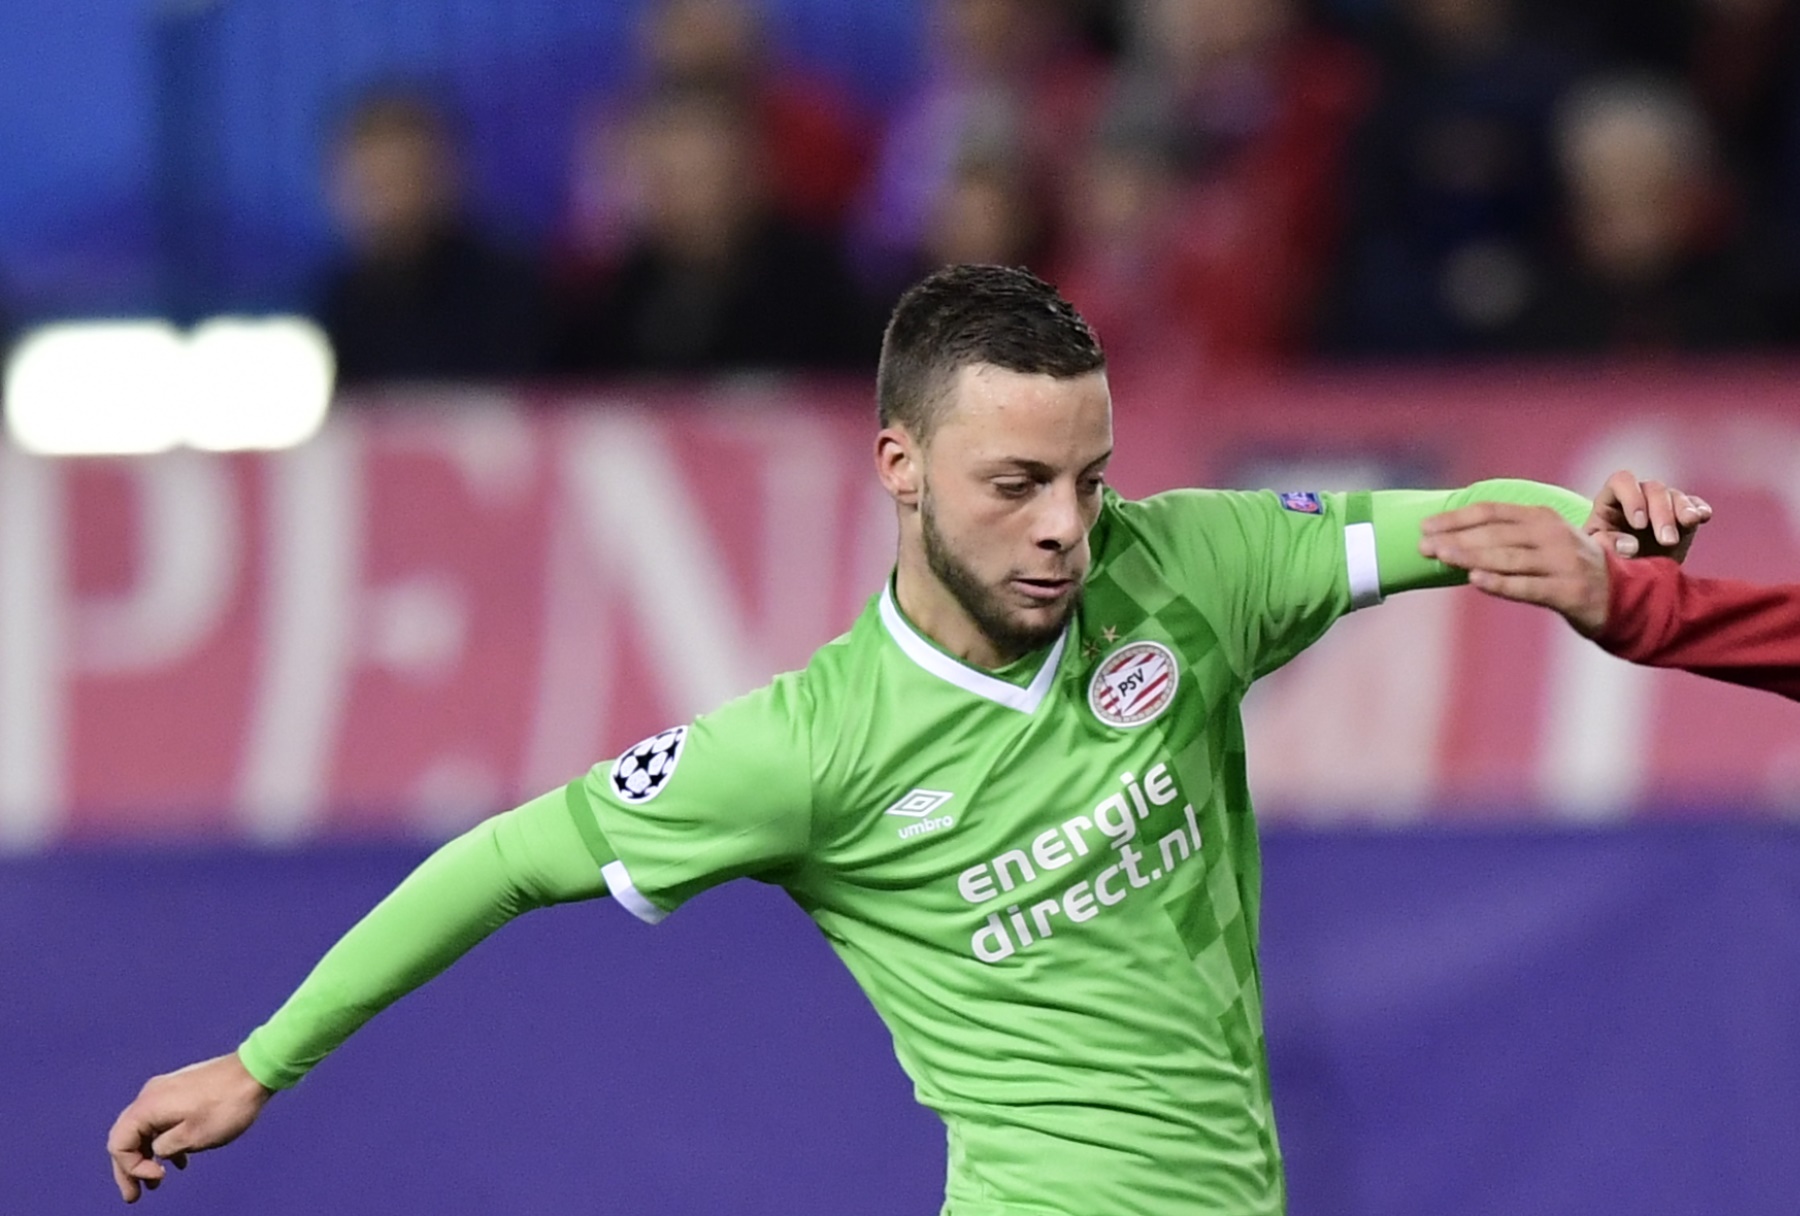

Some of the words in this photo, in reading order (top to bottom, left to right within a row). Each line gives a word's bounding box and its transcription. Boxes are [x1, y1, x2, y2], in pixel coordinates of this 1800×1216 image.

[1117, 667, 1145, 697] PSV
[898, 814, 954, 840] umbro
[957, 762, 1178, 903] energie
[970, 803, 1202, 964] direct.nl
